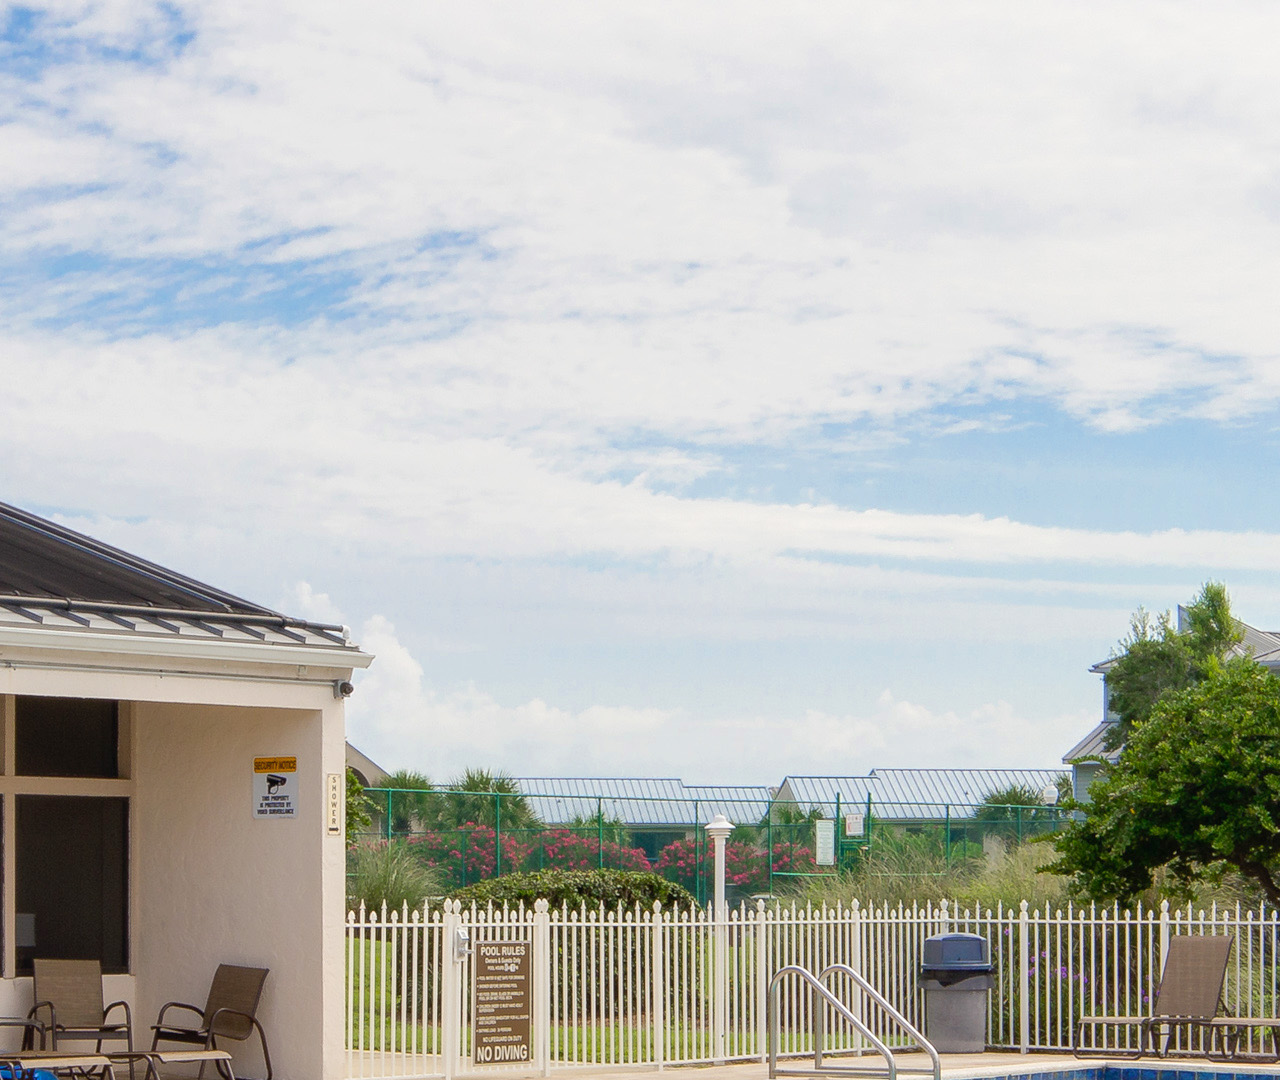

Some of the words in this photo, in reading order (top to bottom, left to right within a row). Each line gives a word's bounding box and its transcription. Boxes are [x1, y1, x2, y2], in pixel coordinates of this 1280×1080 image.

[254, 761, 277, 770] SECURITY
[278, 760, 296, 769] NOTICE
[480, 946, 500, 956] POOL
[501, 946, 526, 956] RULES
[477, 1046, 493, 1062] NO
[494, 1044, 528, 1061] DIVING
